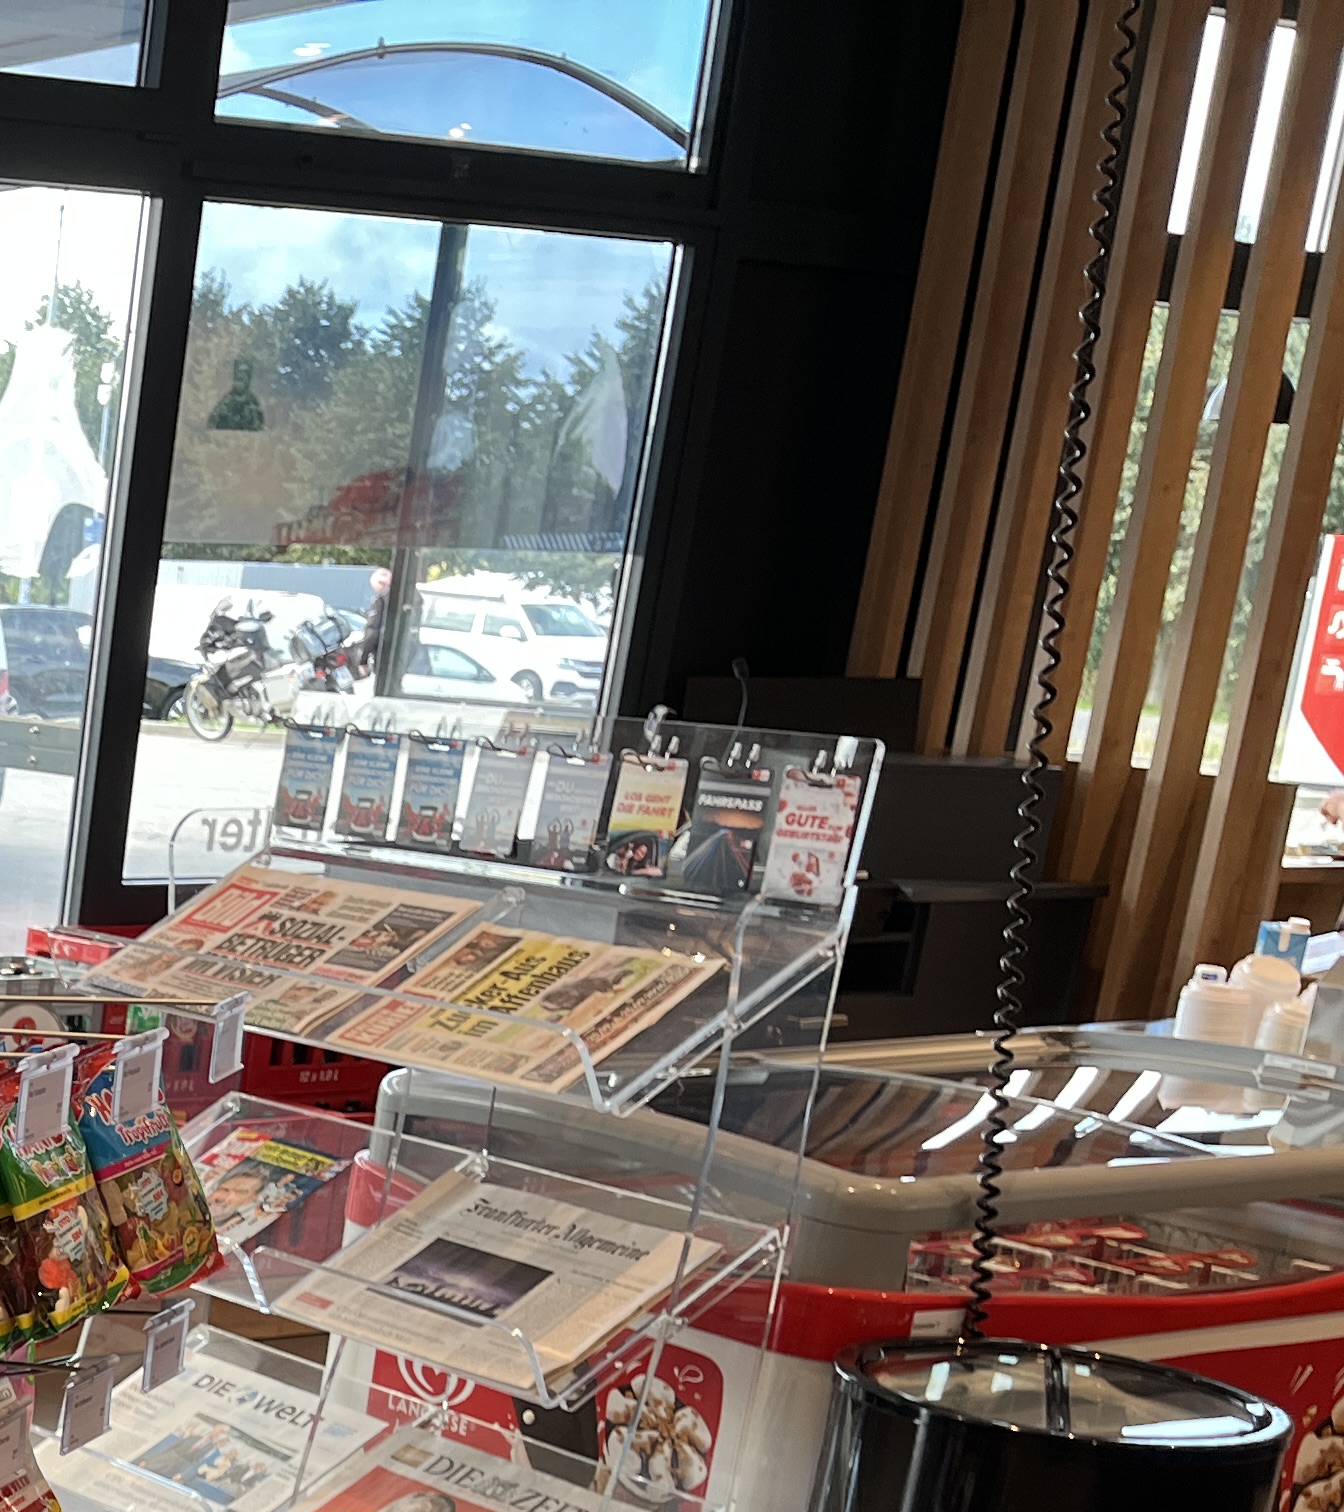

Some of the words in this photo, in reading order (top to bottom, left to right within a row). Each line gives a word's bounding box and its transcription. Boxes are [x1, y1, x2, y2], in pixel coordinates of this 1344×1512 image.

[785, 812, 829, 829] GUTE
[192, 1374, 236, 1398] DIE
[422, 1454, 485, 1490] DIE
